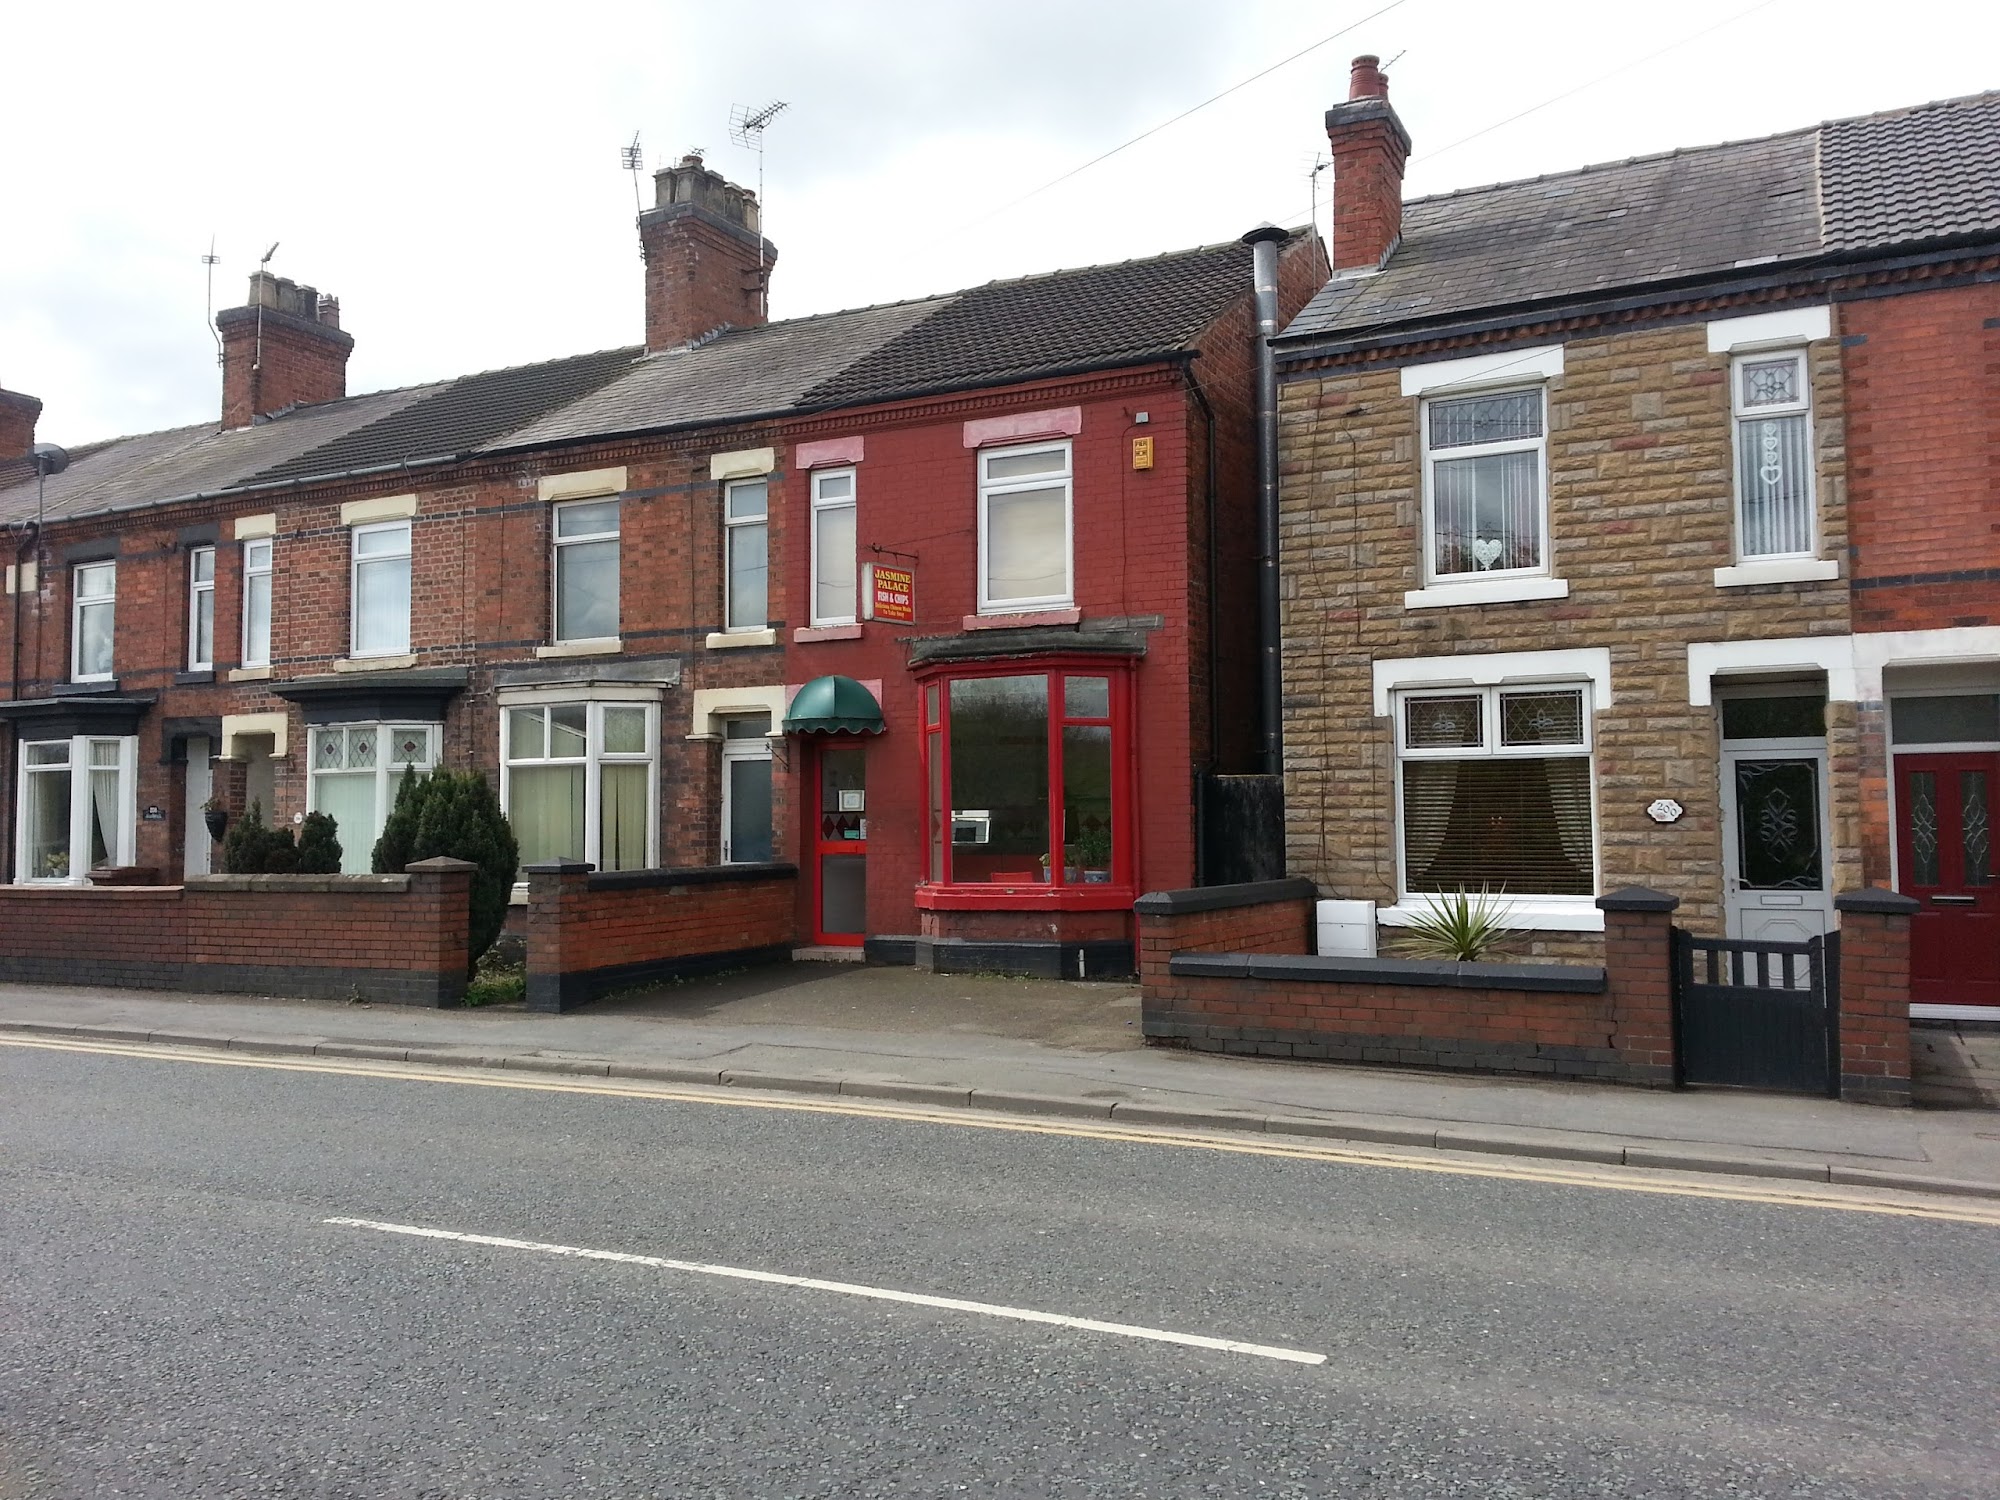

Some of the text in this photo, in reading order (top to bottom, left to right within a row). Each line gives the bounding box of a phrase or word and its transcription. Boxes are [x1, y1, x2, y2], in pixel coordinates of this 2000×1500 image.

[874, 569, 911, 583] JASMINE
[877, 579, 909, 592] PALACE
[877, 591, 889, 602] FISH
[894, 593, 909, 605] CHIPS
[1657, 802, 1677, 817] 200
